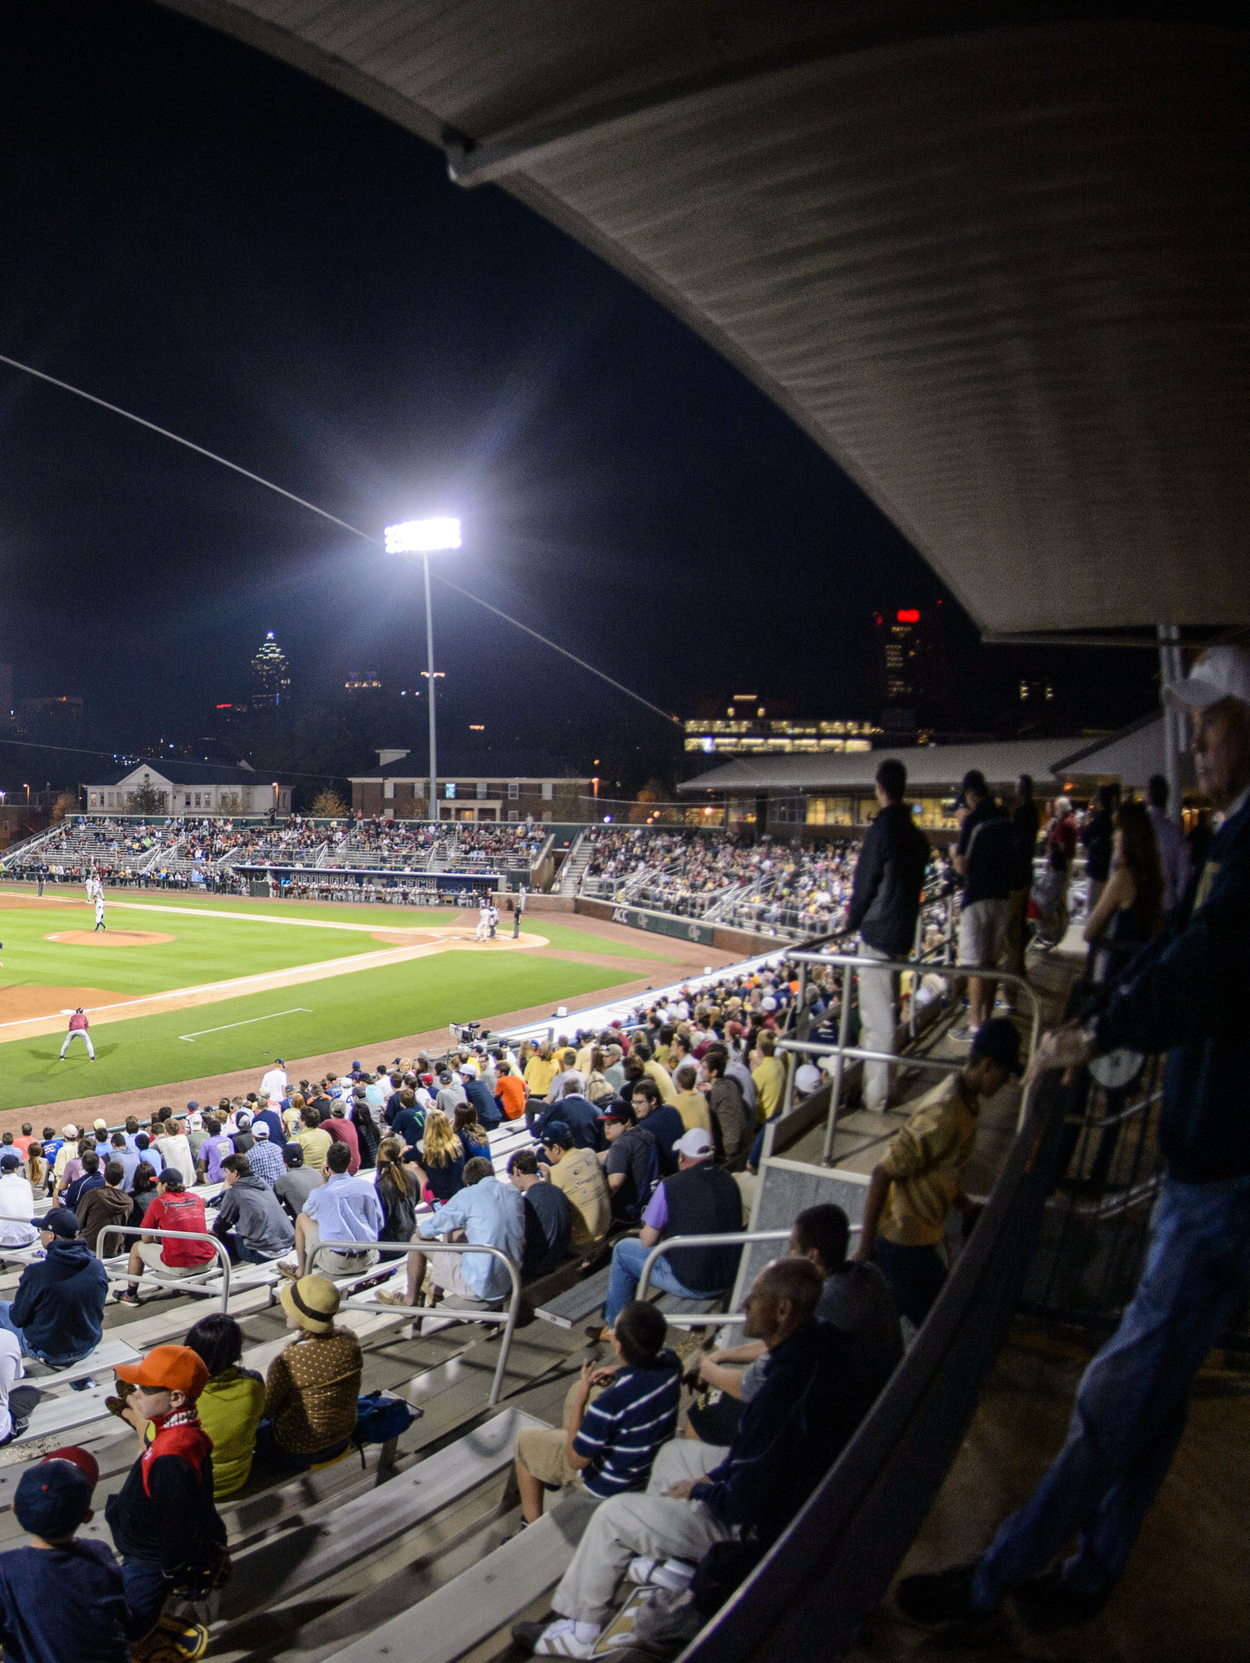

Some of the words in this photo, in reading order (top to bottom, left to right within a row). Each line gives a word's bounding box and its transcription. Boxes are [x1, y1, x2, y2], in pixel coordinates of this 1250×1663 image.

[290, 873, 356, 887] GEORGIA
[395, 877, 437, 890] TECH
[613, 908, 628, 923] ACC
